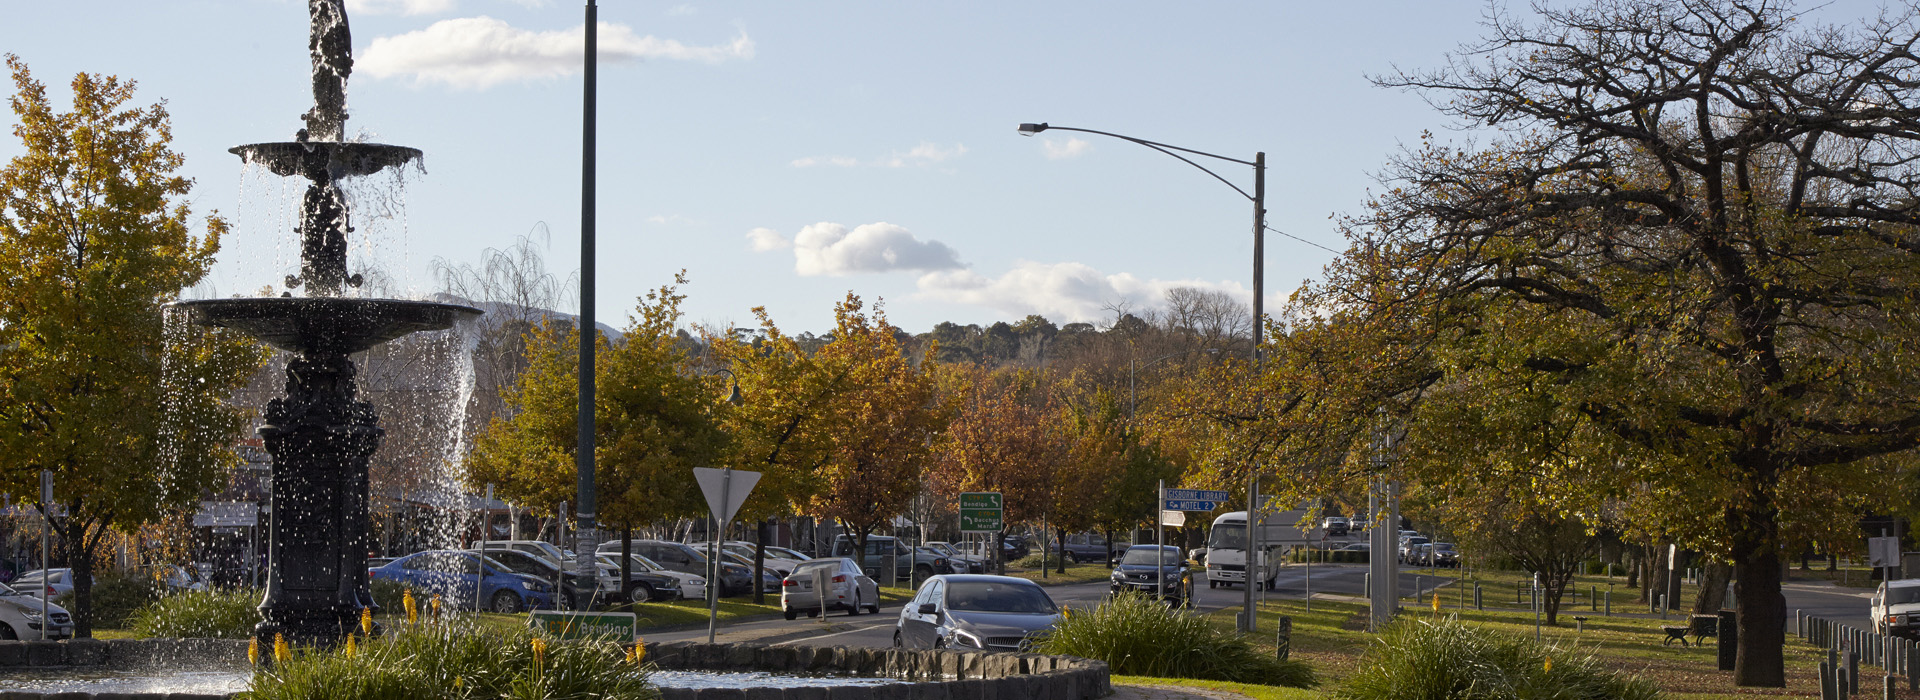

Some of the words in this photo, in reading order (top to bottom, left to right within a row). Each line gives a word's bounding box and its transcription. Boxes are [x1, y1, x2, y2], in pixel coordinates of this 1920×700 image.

[1168, 490, 1198, 500] GISBORNE
[1200, 491, 1227, 501] LIBRARY
[1180, 501, 1201, 510] MOTEL
[1204, 502, 1209, 510] 2
[581, 622, 629, 637] Bendigo
